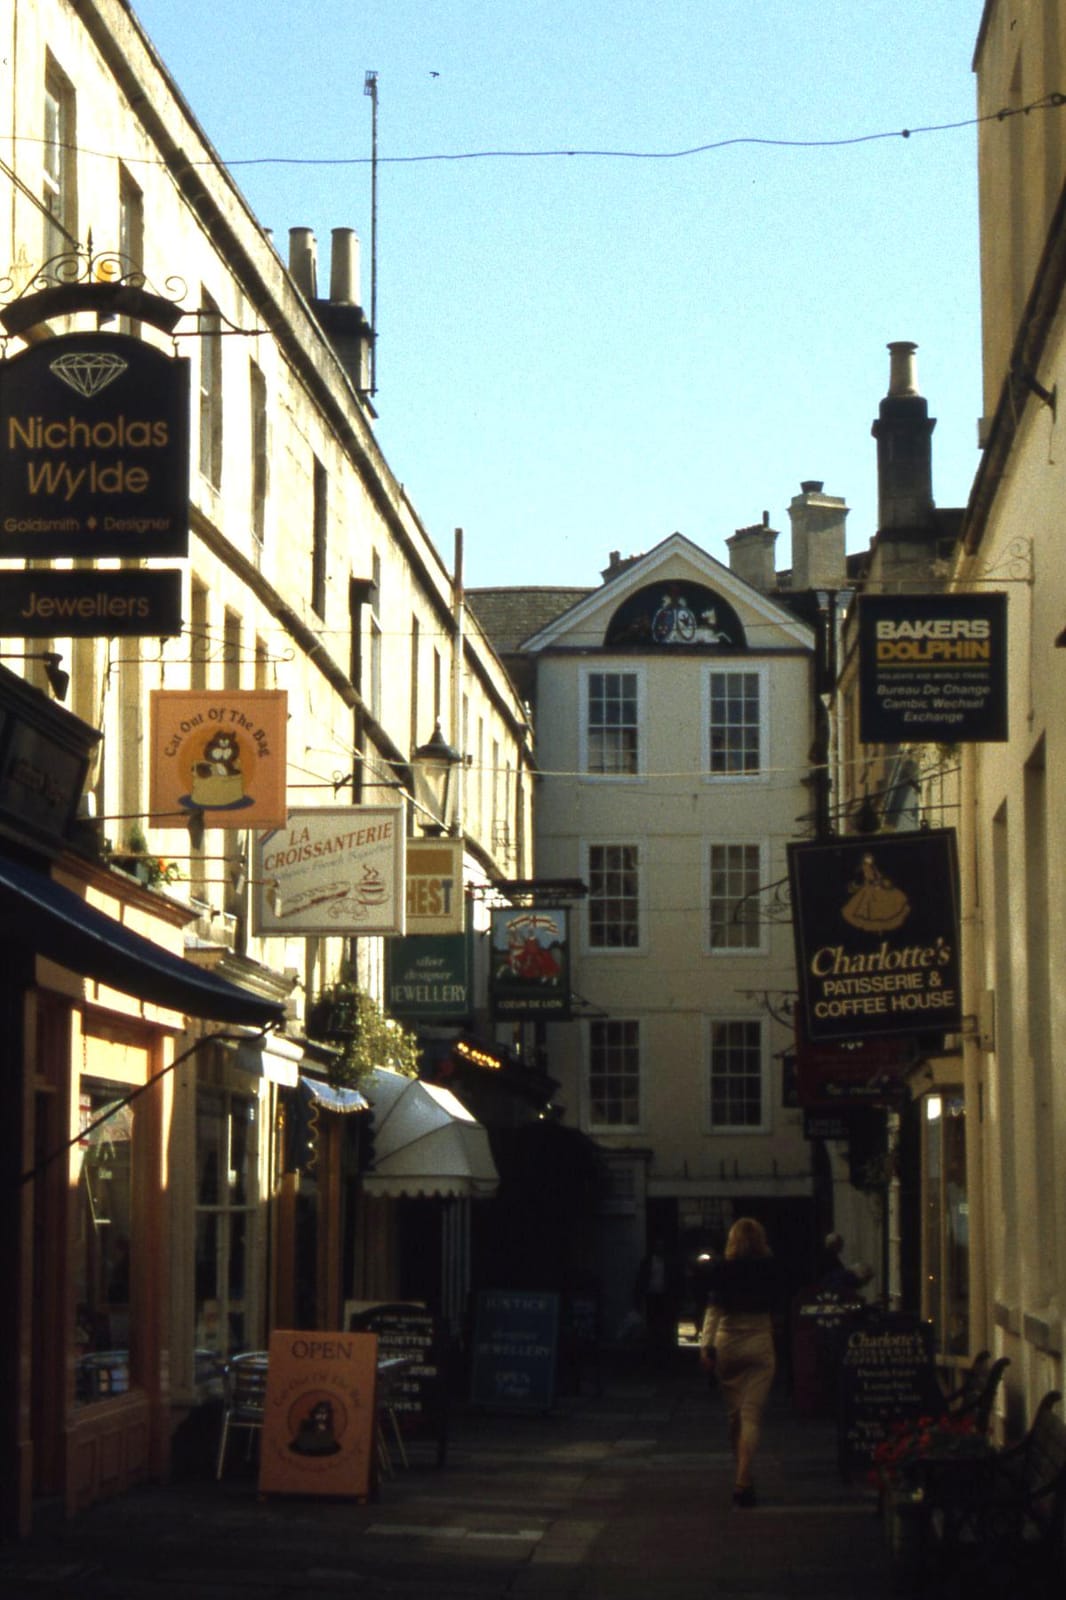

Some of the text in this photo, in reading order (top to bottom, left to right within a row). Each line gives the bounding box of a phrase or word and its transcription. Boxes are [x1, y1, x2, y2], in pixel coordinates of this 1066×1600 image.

[8, 416, 169, 449] Nicholas
[27, 460, 150, 502] Wylde
[4, 516, 171, 533] Goldsmith Designer
[22, 591, 150, 619] Jewellers
[876, 620, 991, 639] BAKERS
[876, 640, 991, 661] DOLPHIN
[876, 683, 991, 698] Bureau De Change
[932, 697, 985, 710] Wechsel
[903, 711, 965, 724] Exchange
[164, 707, 271, 759] Cat Out Of The Bag
[263, 821, 394, 872] CROISSANTERIE
[289, 826, 311, 847] LA
[810, 936, 951, 978] Charlotte's
[390, 984, 468, 1003] JEWELLERY
[823, 970, 943, 998] PATISSERIE &
[814, 989, 956, 1019] COFFEE HOUSE
[291, 1340, 352, 1359] OPEN
